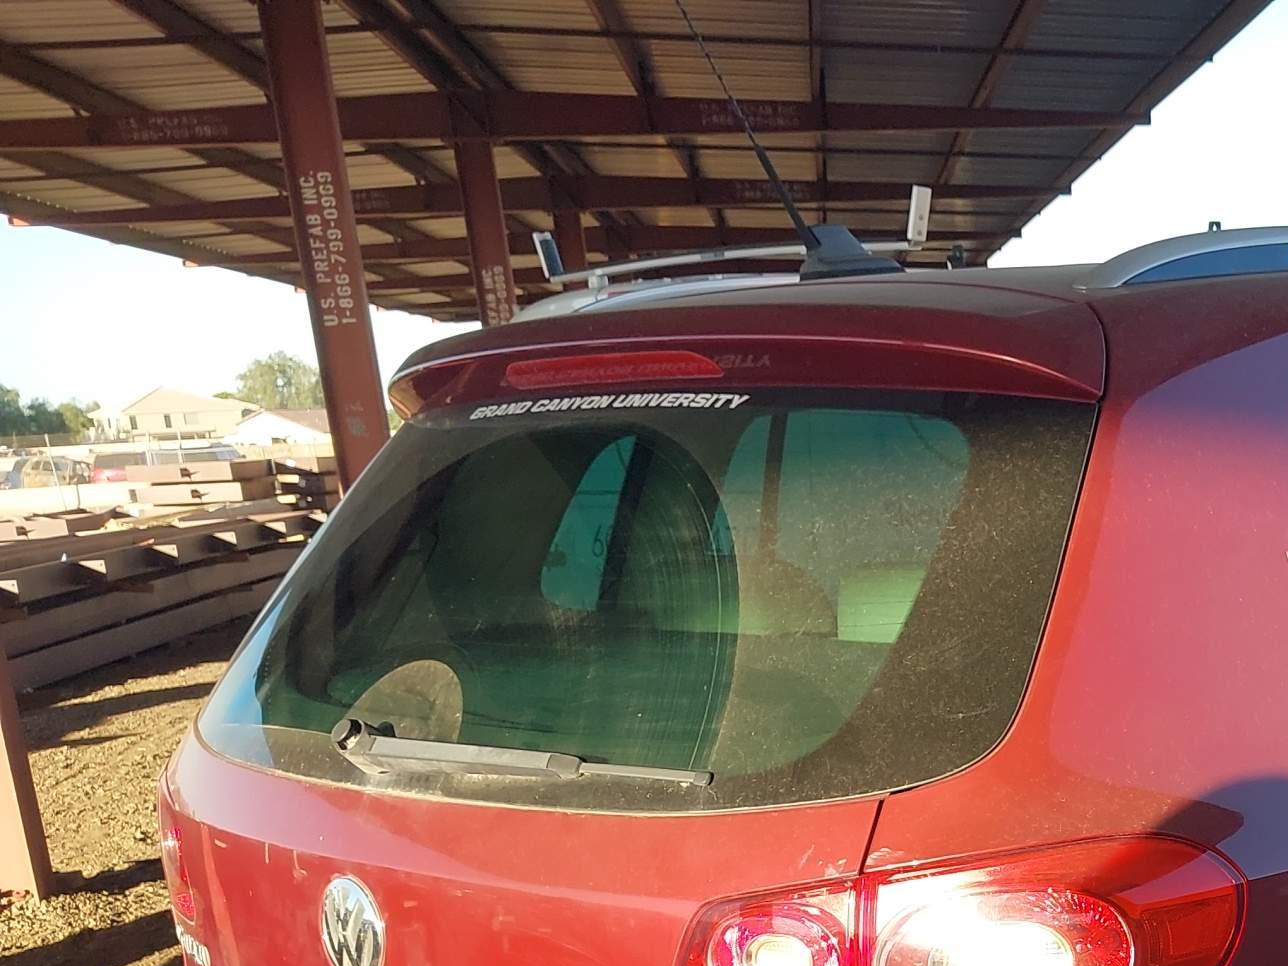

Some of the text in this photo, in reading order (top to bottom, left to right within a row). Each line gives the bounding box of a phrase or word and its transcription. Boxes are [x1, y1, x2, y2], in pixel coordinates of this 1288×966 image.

[299, 171, 340, 327] U.S. PREFAB INC.
[317, 171, 358, 325] 1-866-799-0969
[469, 392, 750, 420] GRAND CANYON UNIVERSITY
